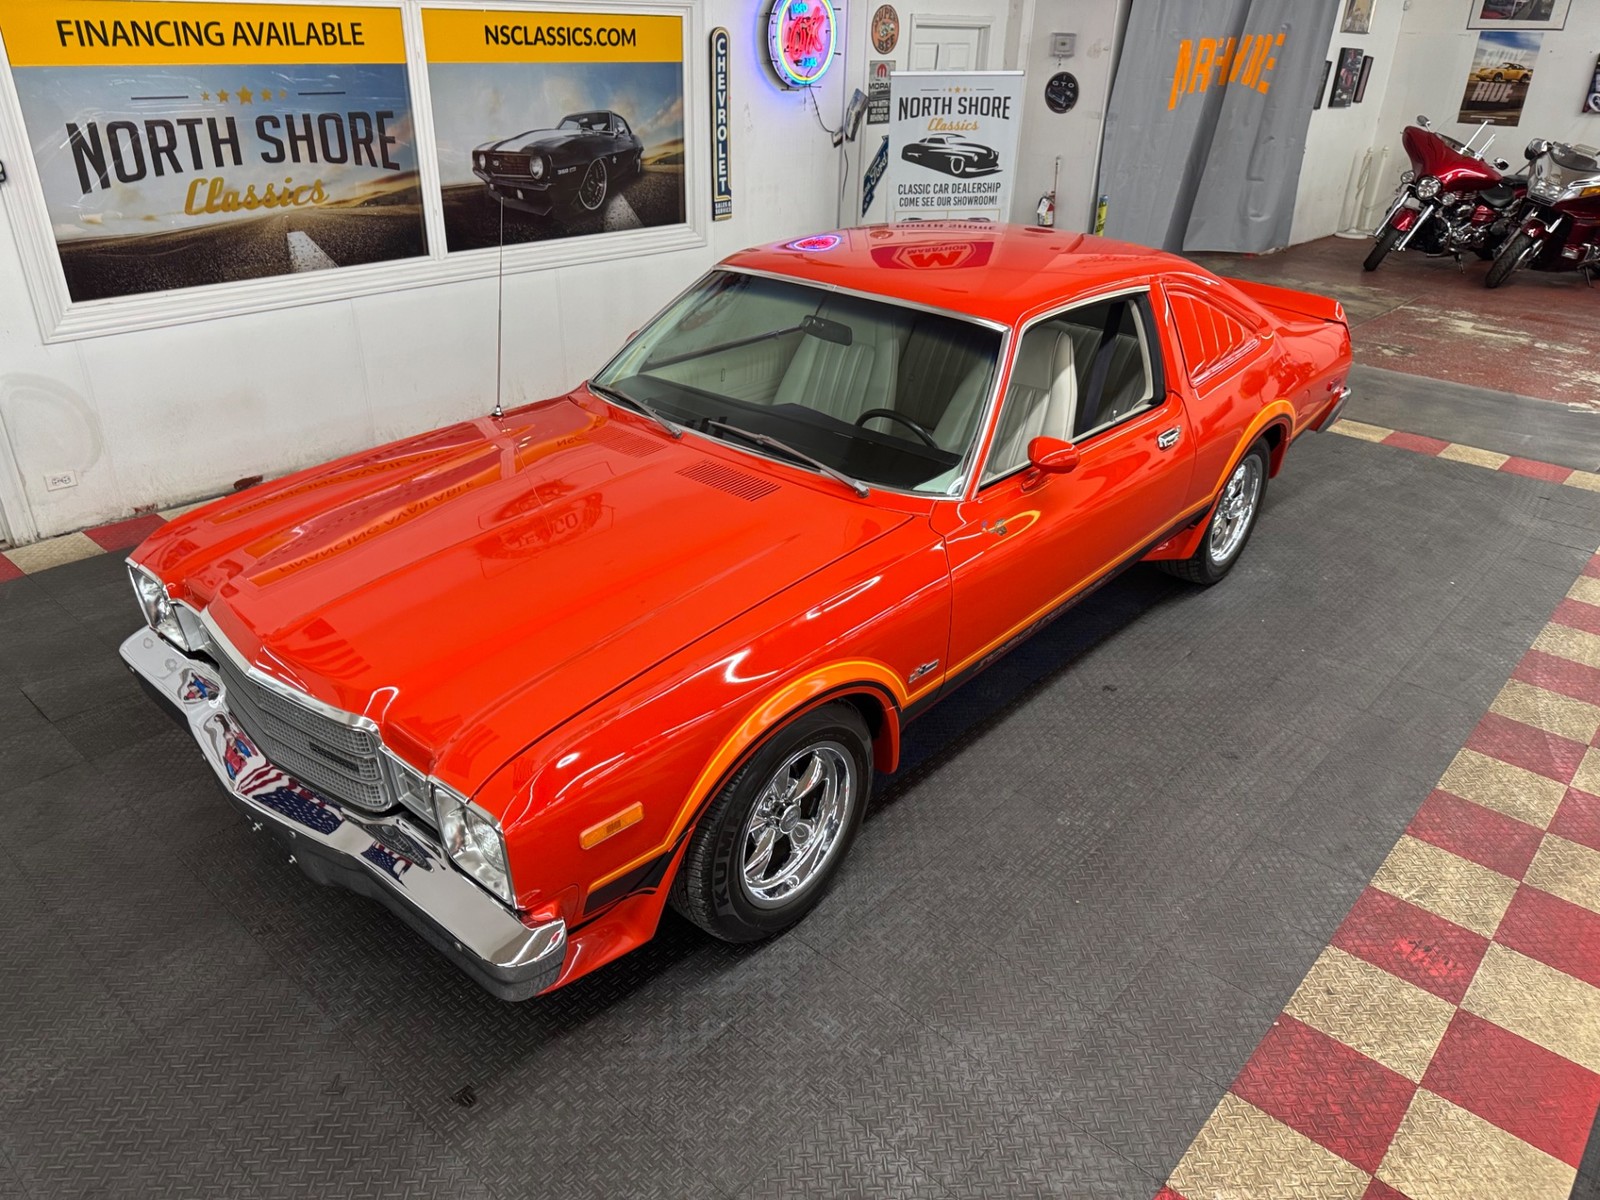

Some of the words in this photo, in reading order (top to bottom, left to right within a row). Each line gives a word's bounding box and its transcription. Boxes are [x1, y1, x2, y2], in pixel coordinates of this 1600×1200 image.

[56, 19, 226, 47] FINANCING
[232, 22, 365, 46] AVAILABLE
[484, 25, 637, 47] NSCLASSICS.COM
[1052, 80, 1075, 88] GTO
[1471, 82, 1513, 102] RIDE
[716, 38, 727, 193] CHEVROLET
[898, 97, 952, 121] NORTH
[958, 96, 1011, 120] SHORE
[928, 118, 979, 131] Classics
[65, 116, 243, 195] NORTH
[255, 110, 401, 171] SHORE
[183, 176, 330, 216] Classics
[898, 183, 931, 195] CLASSIC
[933, 183, 949, 194] CAR
[951, 182, 1001, 194] DEALERSHIP
[899, 197, 920, 207] COME
[921, 197, 935, 207] SEE
[937, 196, 951, 206] OUR
[953, 195, 998, 206] SHOWROOM!
